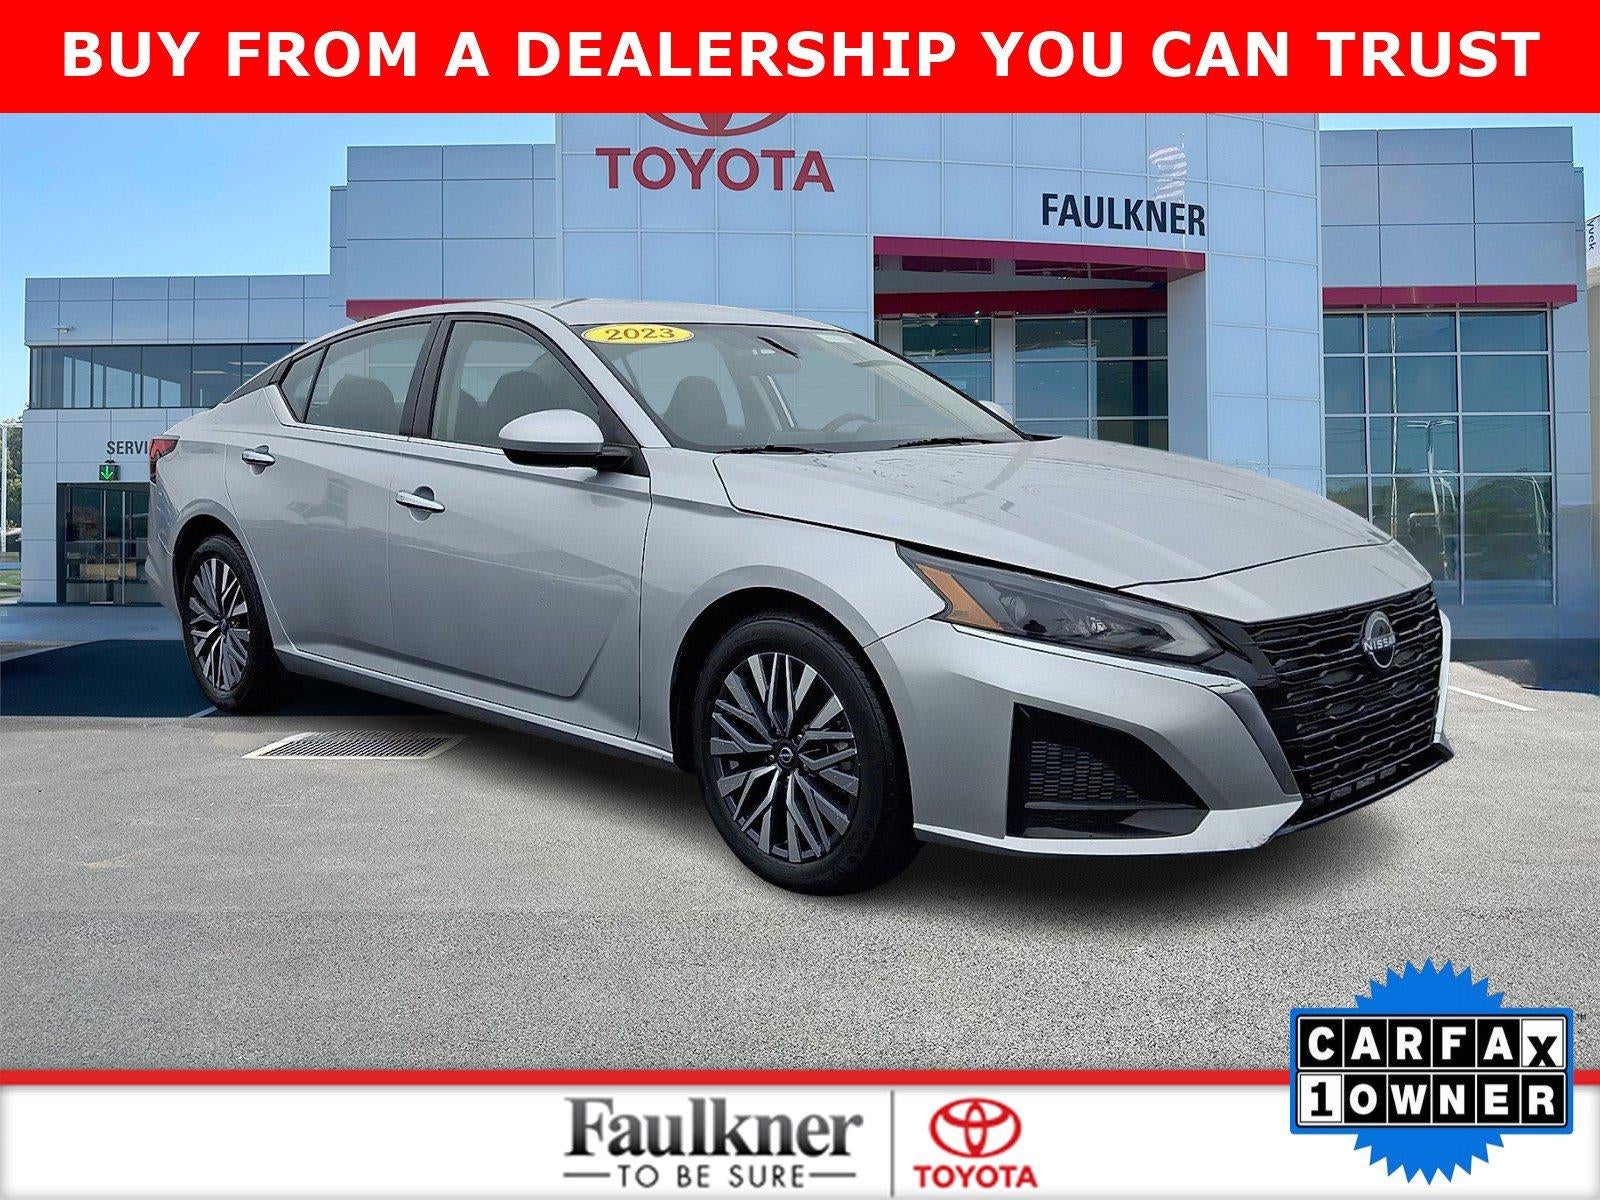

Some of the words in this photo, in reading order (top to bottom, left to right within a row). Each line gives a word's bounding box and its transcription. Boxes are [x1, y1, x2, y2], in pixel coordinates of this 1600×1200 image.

[596, 147, 834, 192] TOYOTA
[1041, 192, 1206, 237] FAULKNER
[605, 327, 675, 341] 2023
